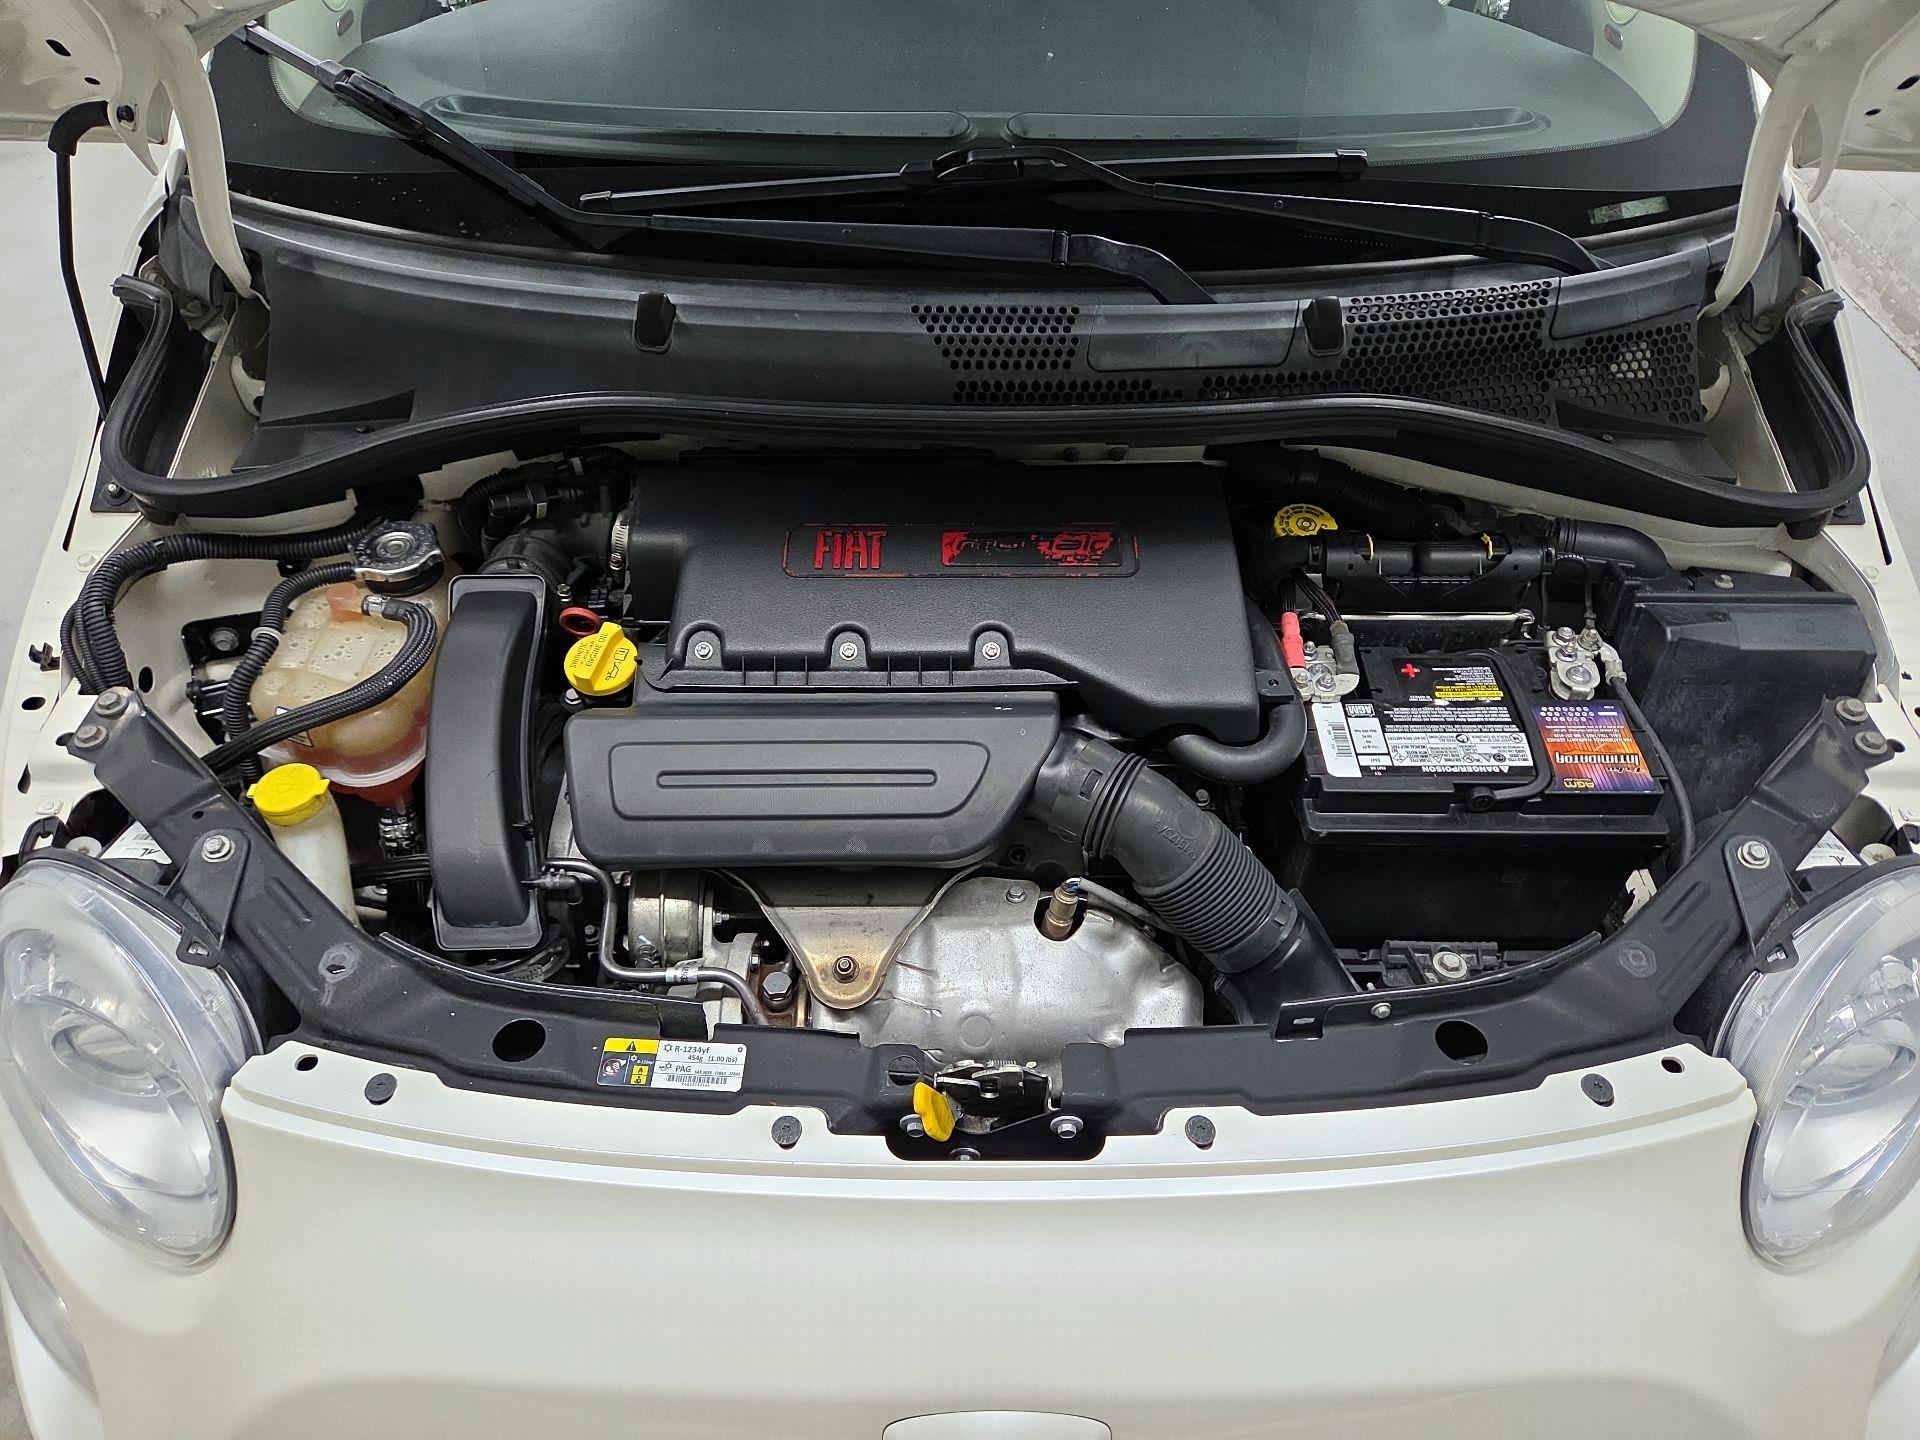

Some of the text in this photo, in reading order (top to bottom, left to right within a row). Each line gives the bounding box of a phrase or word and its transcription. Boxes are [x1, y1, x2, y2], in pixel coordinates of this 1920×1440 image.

[814, 528, 887, 569] FIAT
[584, 643, 603, 667] ENGINE
[598, 632, 609, 643] OIL
[1348, 705, 1373, 715] AGM
[1556, 752, 1639, 766] INTIMIDATOR
[1422, 765, 1500, 773] DANGER/POISON
[674, 1045, 710, 1055] R-1234yf
[687, 1054, 703, 1063] 454g
[675, 1065, 692, 1073] PAG
